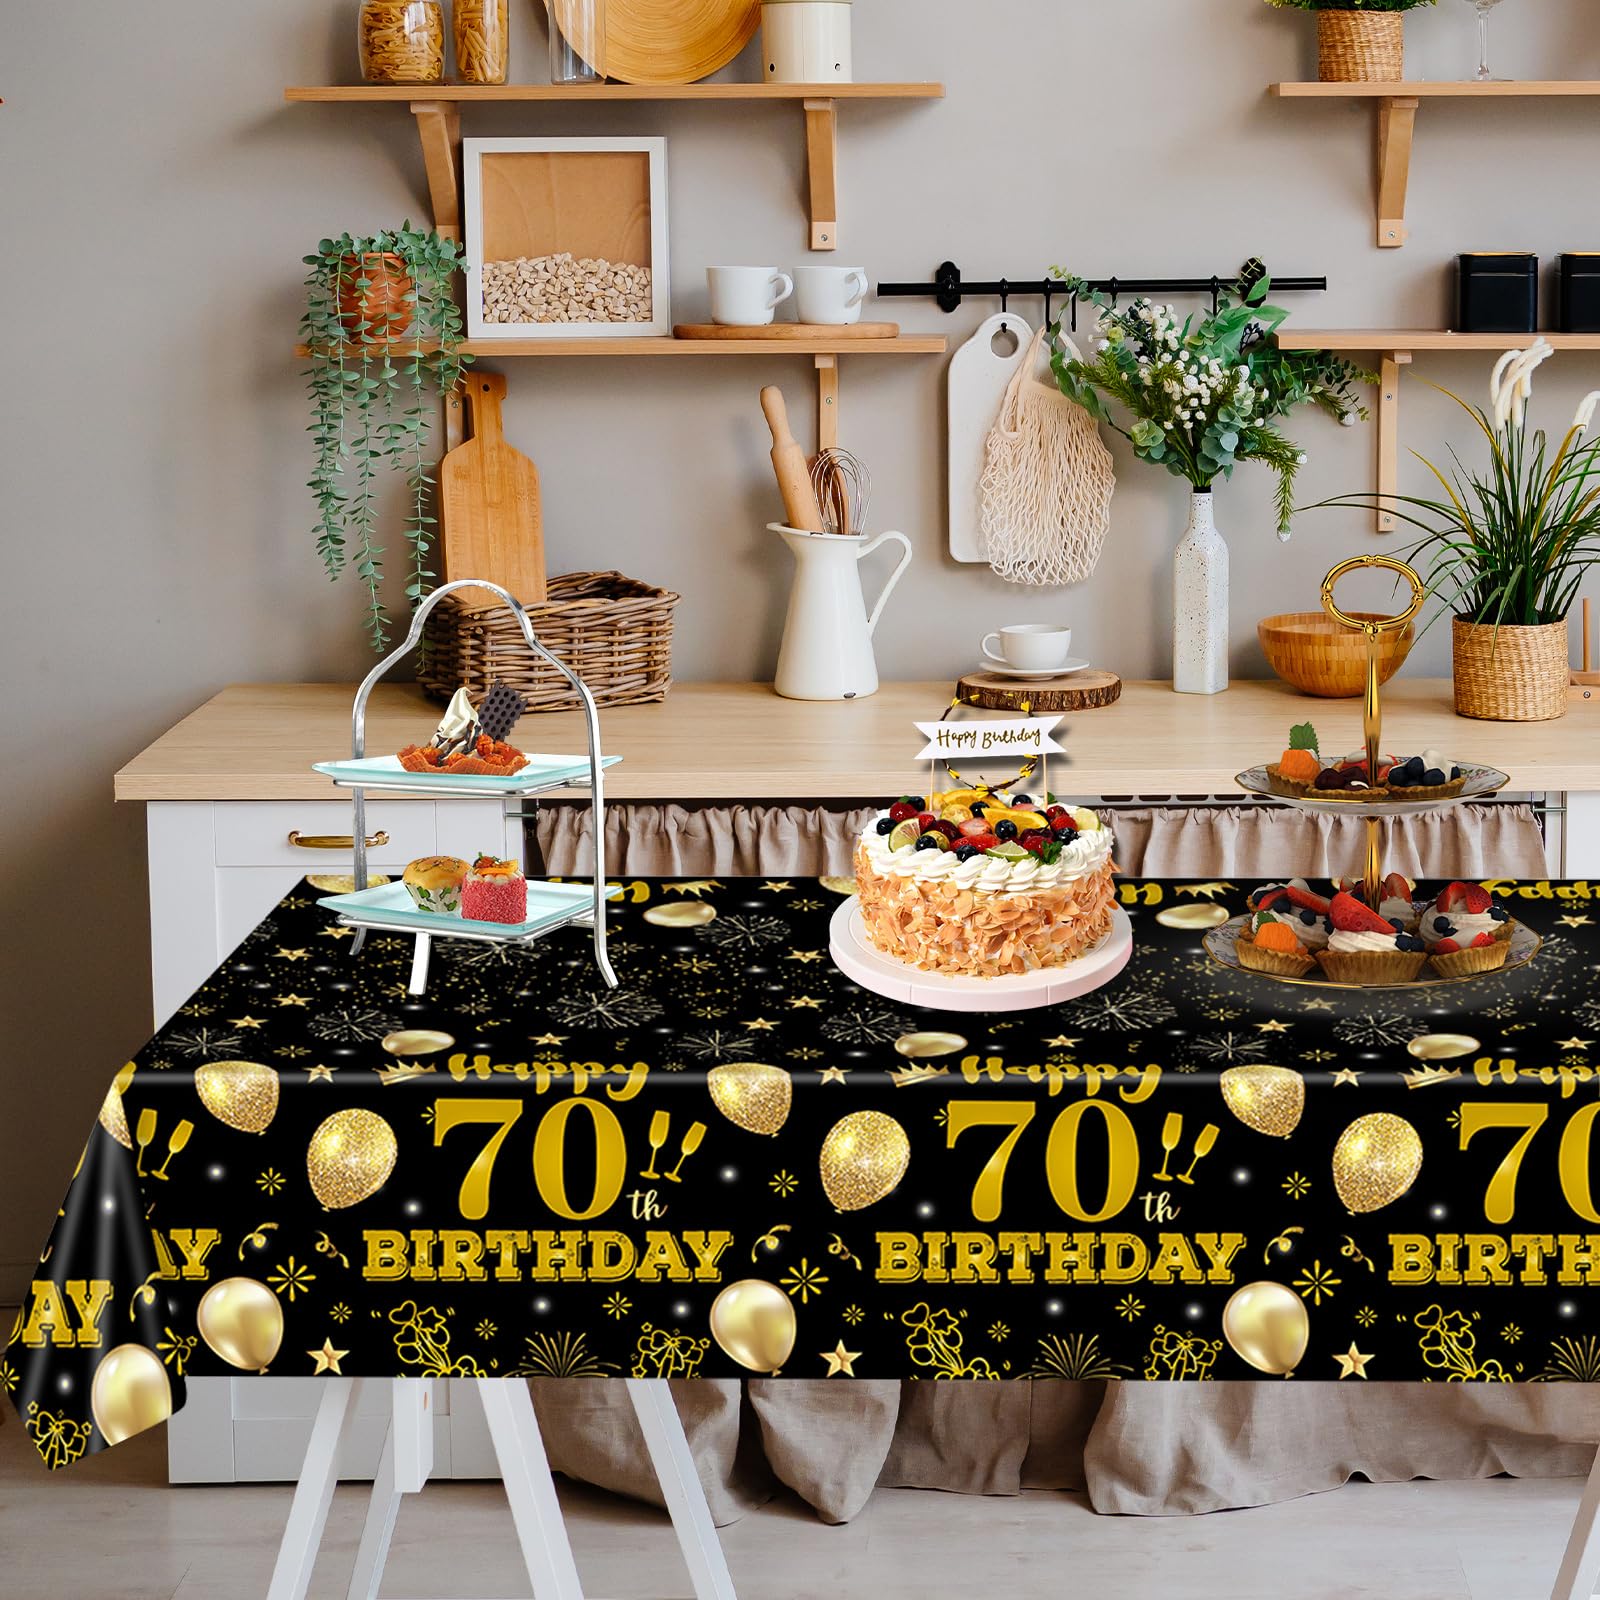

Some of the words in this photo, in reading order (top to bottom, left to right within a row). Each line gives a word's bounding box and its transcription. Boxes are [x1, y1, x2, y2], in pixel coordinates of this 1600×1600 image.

[936, 728, 977, 749] Happy
[981, 727, 1041, 750] Birthday
[448, 1053, 649, 1102] Happy
[960, 1055, 1162, 1104] Happy
[1473, 1057, 1600, 1099] Hap
[433, 1096, 627, 1221] 70
[627, 1190, 667, 1222] th
[945, 1098, 1139, 1223] 70
[1139, 1192, 1180, 1224] th
[362, 1229, 735, 1283] BIRTHDAY
[874, 1231, 1247, 1285] BIRTHDAY
[1387, 1233, 1600, 1287] BIRTH
